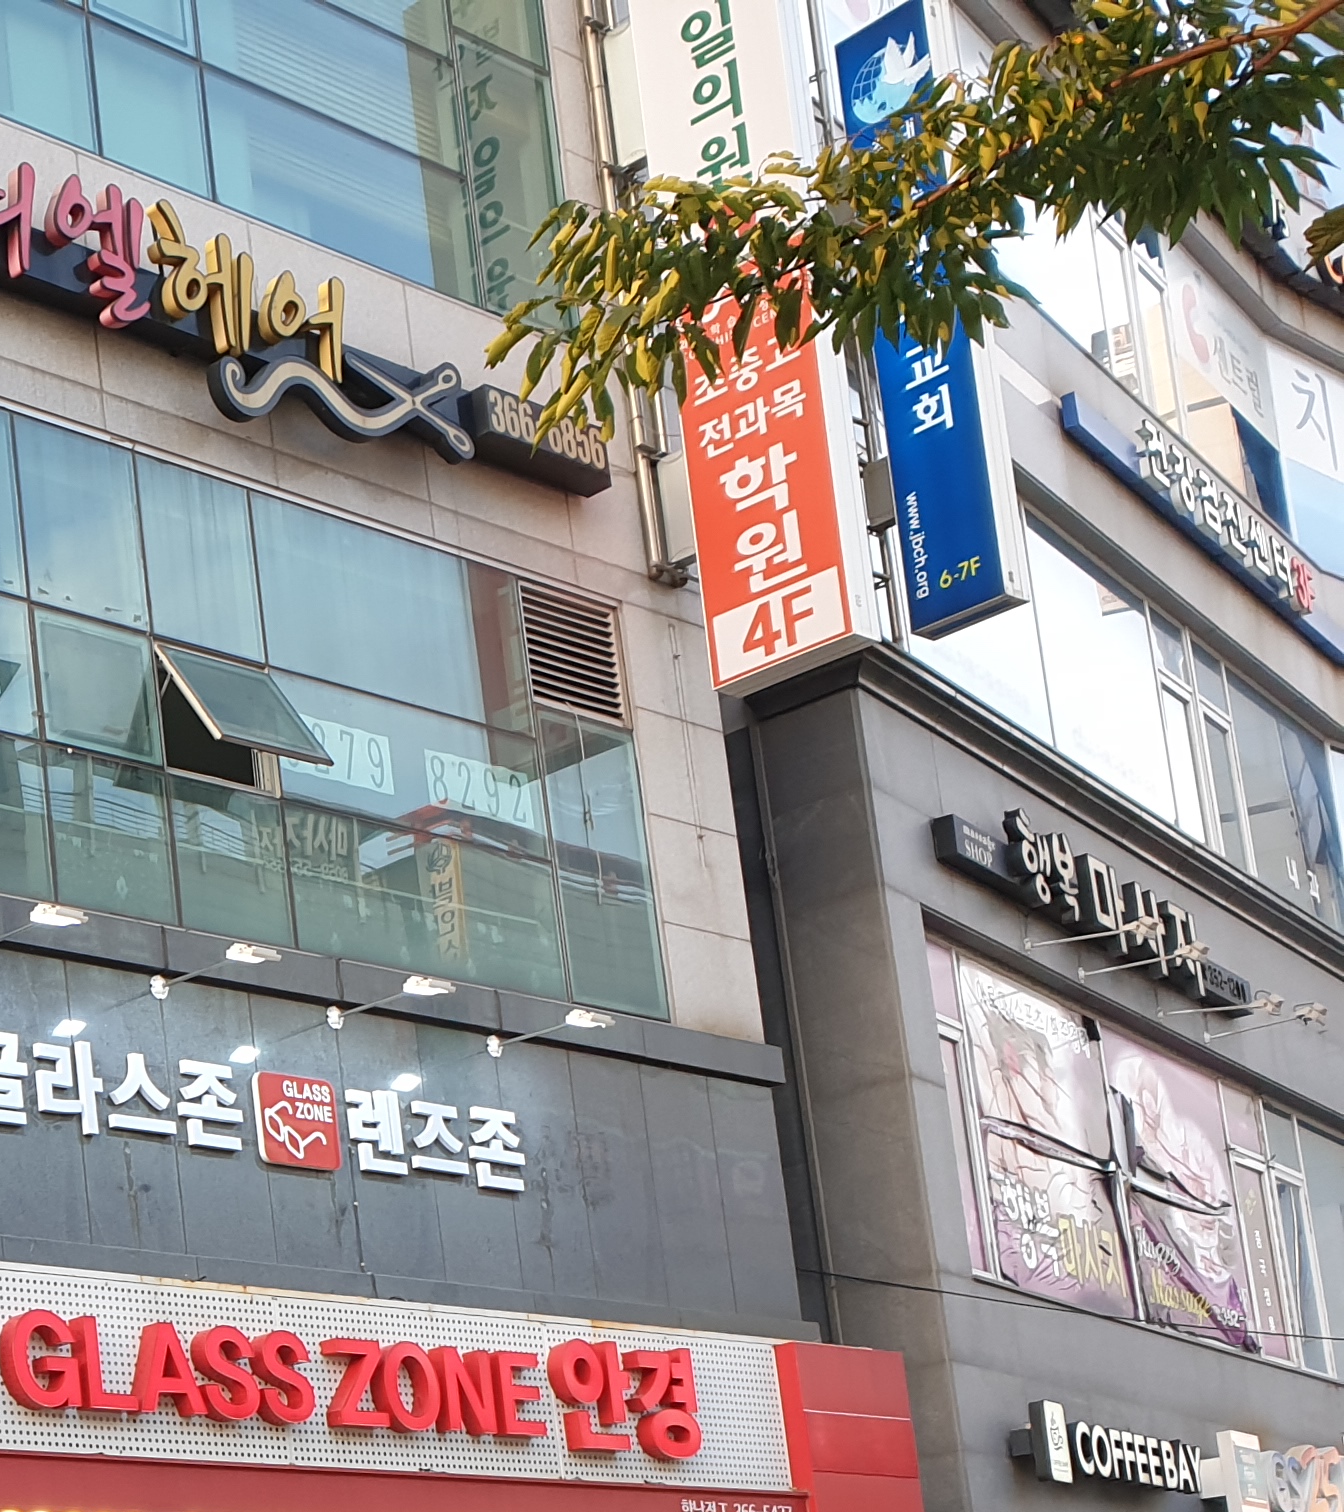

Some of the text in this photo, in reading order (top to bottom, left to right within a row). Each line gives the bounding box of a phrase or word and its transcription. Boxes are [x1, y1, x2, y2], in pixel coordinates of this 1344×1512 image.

[698, 379, 807, 460] 전과목
[719, 441, 810, 595] 학원
[939, 555, 982, 591] 6-7F
[742, 584, 815, 658] 4F
[429, 753, 529, 824] 8292
[964, 838, 993, 869] SHOP
[282, 1079, 331, 1104] GLASS
[294, 1101, 334, 1124] ZONE
[319, 1338, 549, 1438] ZONE
[549, 1337, 706, 1462] 안경
[1074, 1420, 1202, 1494] COFFEEBAY
